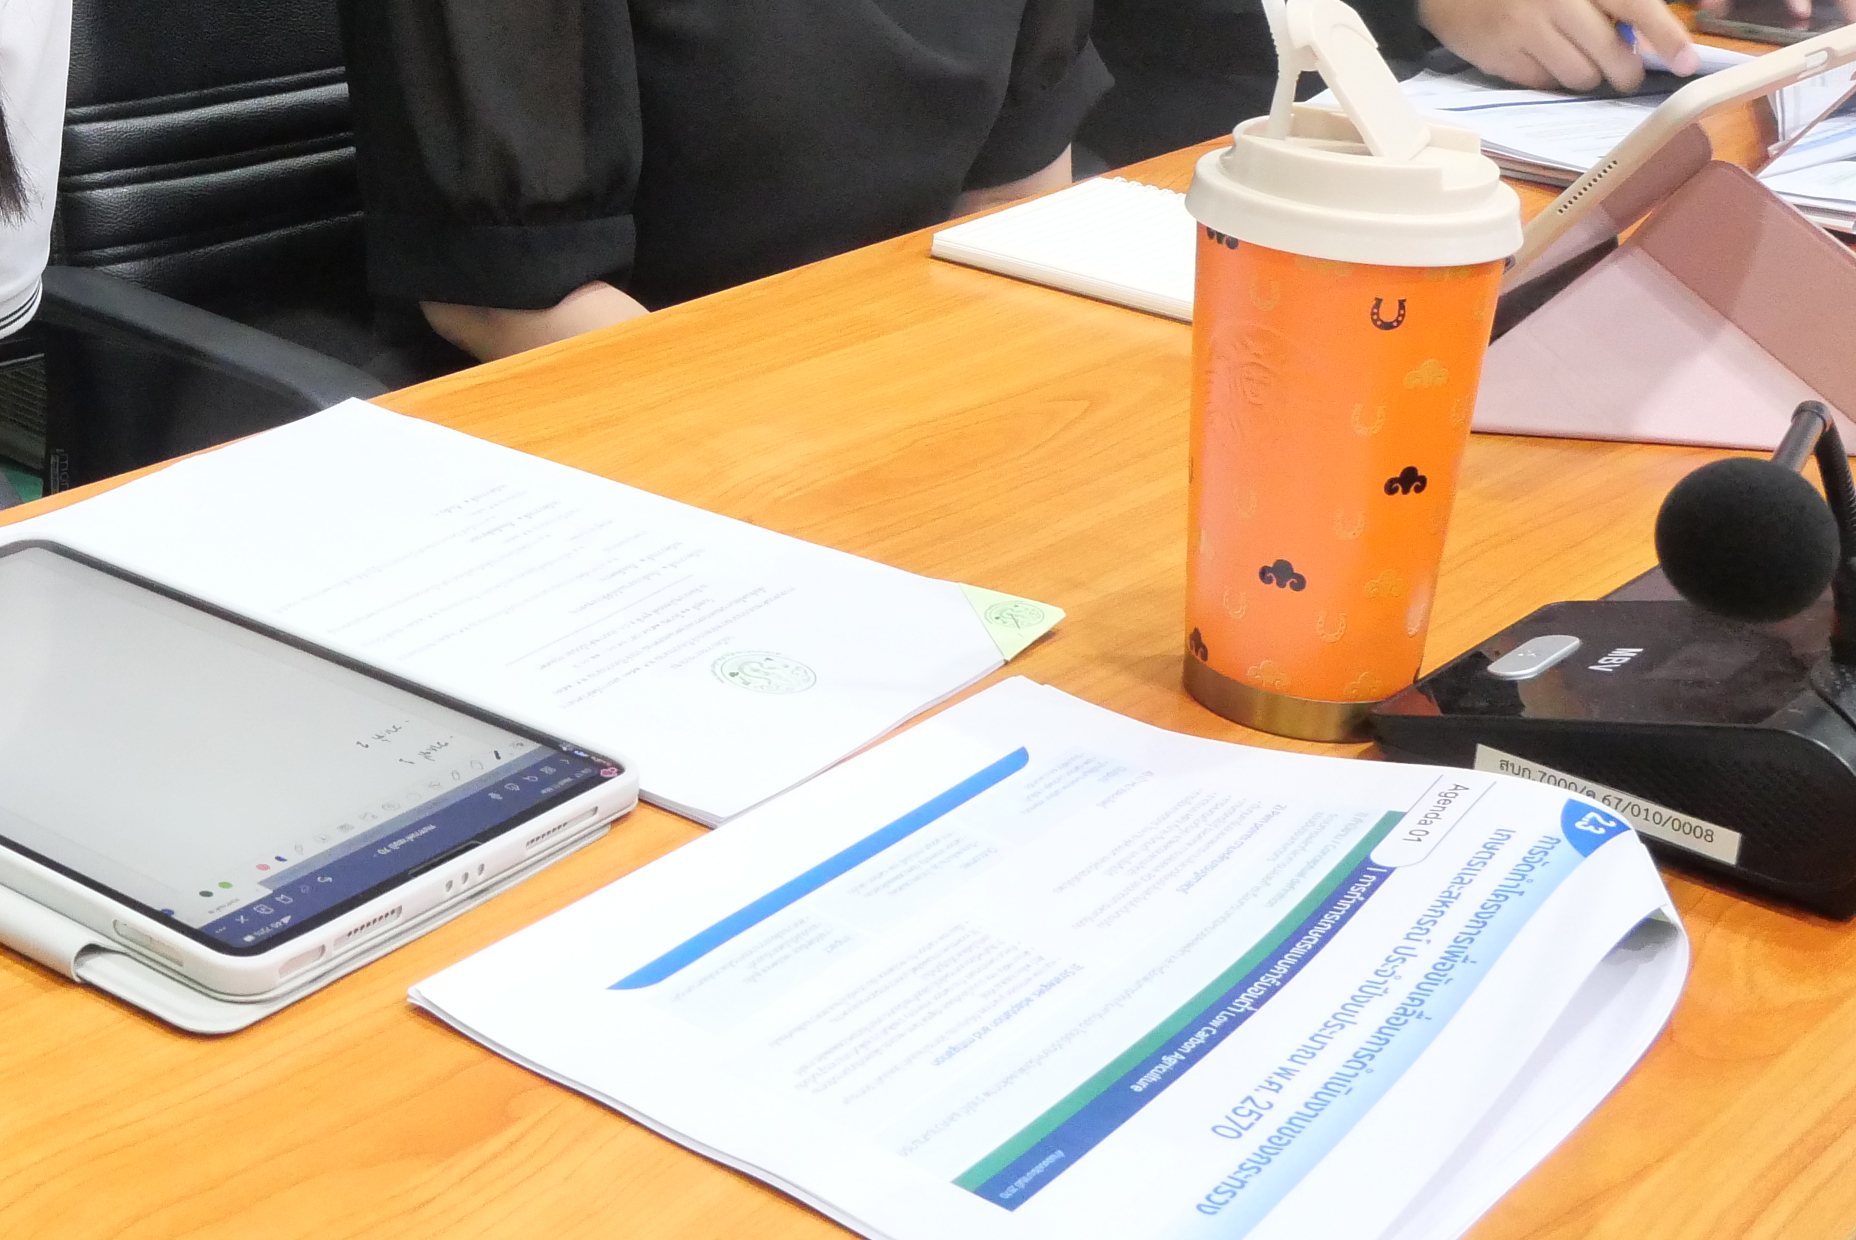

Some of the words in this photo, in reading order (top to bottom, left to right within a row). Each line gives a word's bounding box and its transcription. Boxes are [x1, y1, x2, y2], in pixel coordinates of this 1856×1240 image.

[1587, 646, 1644, 674] MBV
[1420, 782, 1469, 826] Agenda
[1403, 827, 1431, 843] 01
[1403, 829, 1516, 949] เกษตรและสหกรณ์
[1210, 1012, 1229, 1035] Low
[1287, 946, 1417, 1065] ประจำปีงบประมาณ
[1179, 1025, 1211, 1055] Carbon
[1130, 1050, 1186, 1093] Agriculture
[1255, 1067, 1299, 1093] พ.ศ.
[1211, 1094, 1273, 1139] 2570
